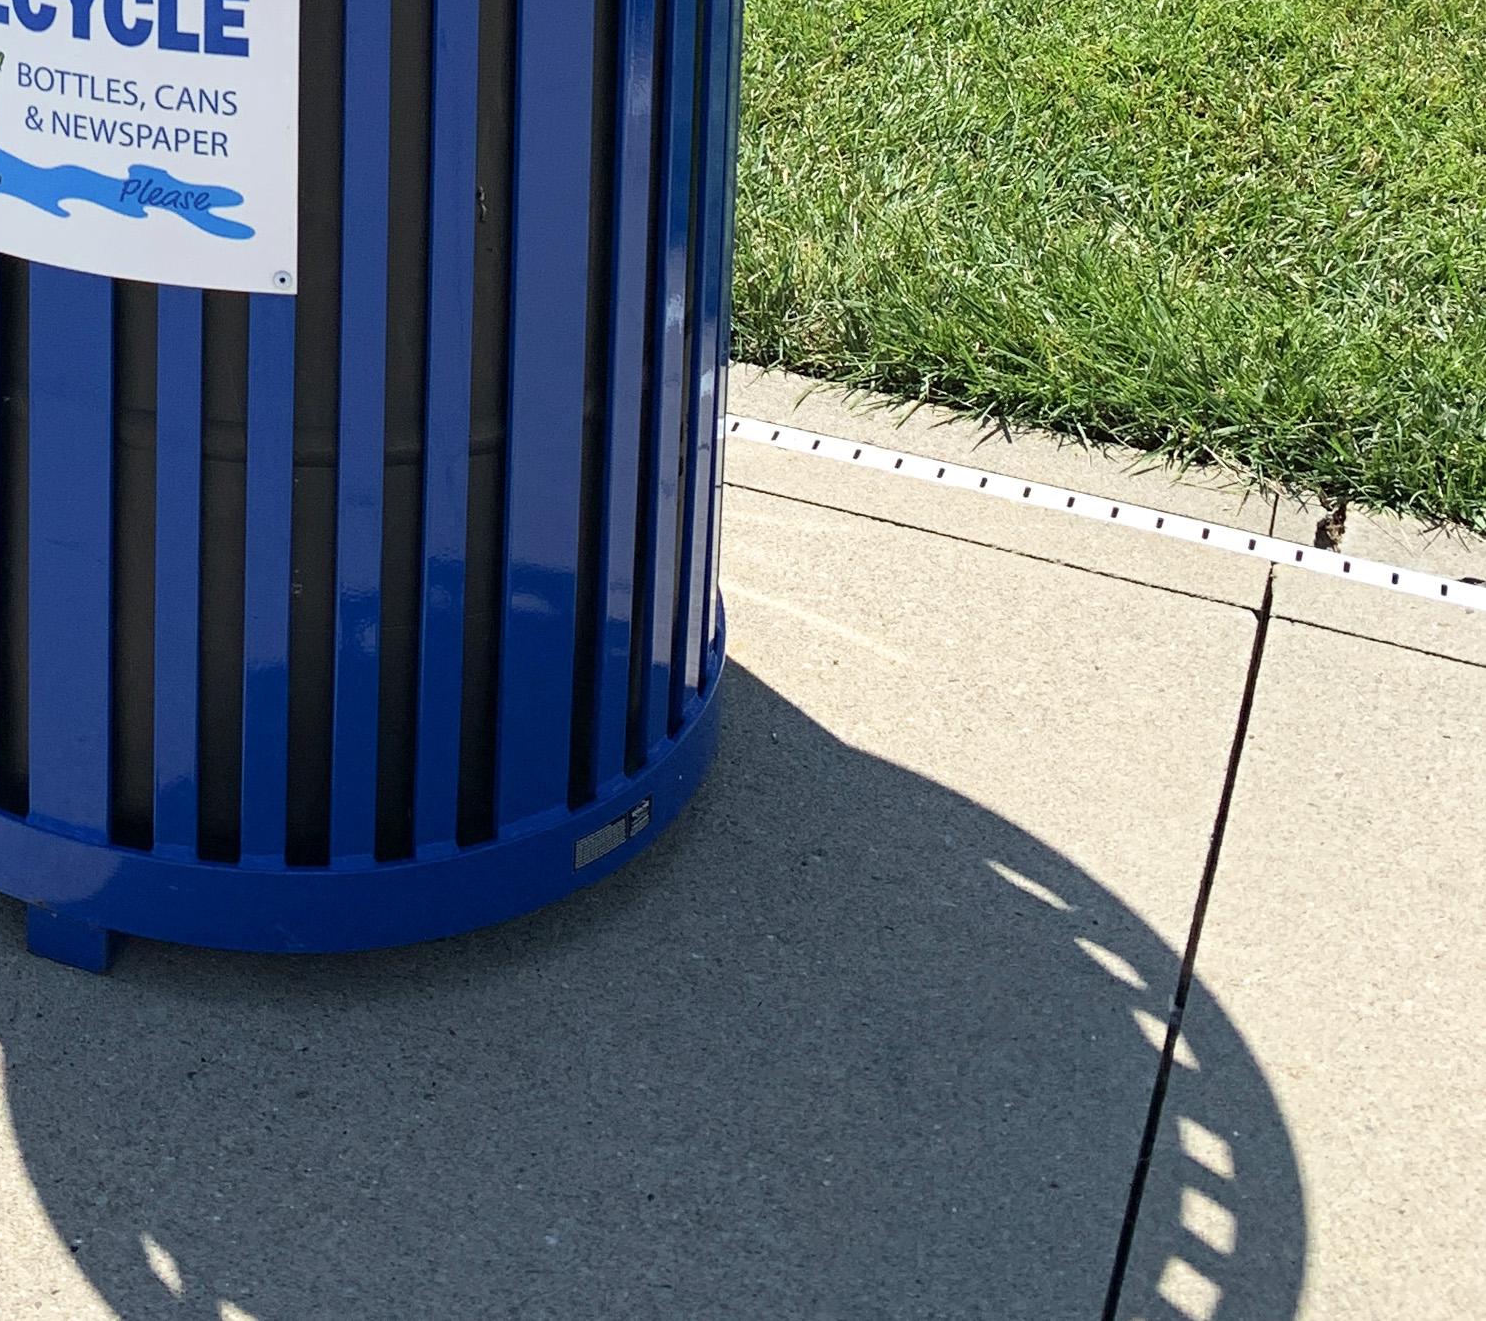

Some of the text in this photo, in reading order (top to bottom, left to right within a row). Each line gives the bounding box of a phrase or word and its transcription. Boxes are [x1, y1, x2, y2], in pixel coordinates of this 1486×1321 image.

[17, 62, 238, 116] BOTTLES, CANS
[24, 106, 229, 157] & NEWSPAPER
[120, 178, 212, 211] Please
